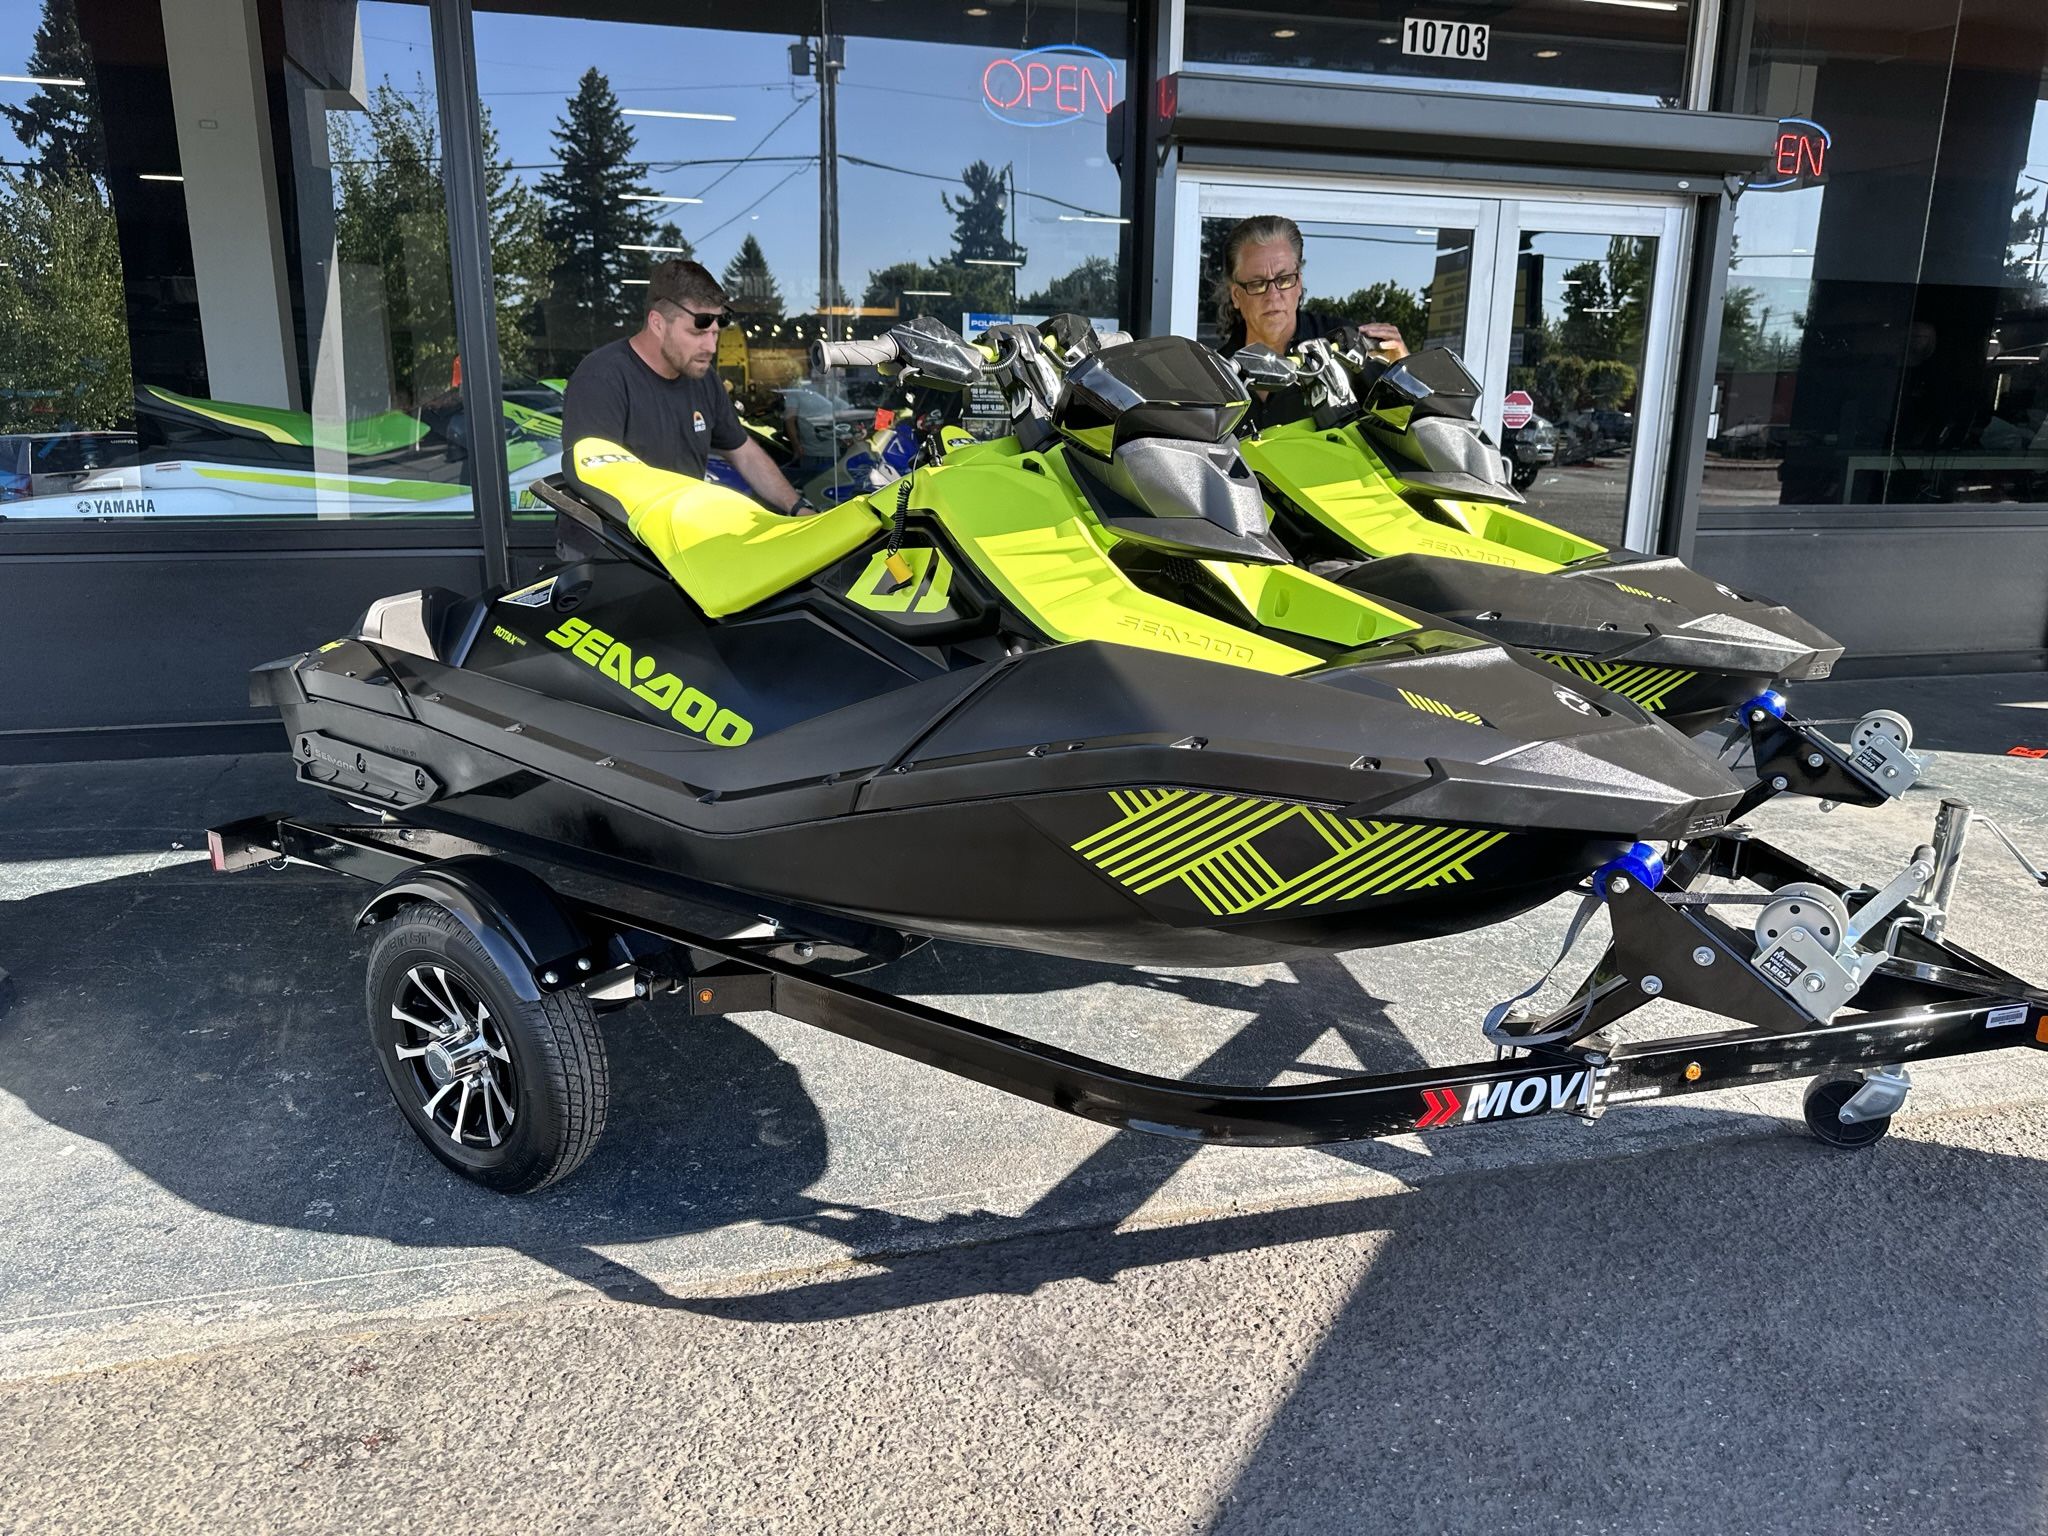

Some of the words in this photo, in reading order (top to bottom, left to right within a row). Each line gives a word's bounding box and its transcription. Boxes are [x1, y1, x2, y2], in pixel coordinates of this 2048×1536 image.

[1408, 20, 1486, 58] 10703
[984, 58, 1113, 114] OPEN
[1777, 133, 1825, 177] EN
[94, 499, 156, 514] YAMAHA
[493, 625, 517, 645] ROTAX
[1461, 1068, 1612, 1122] MOVE
